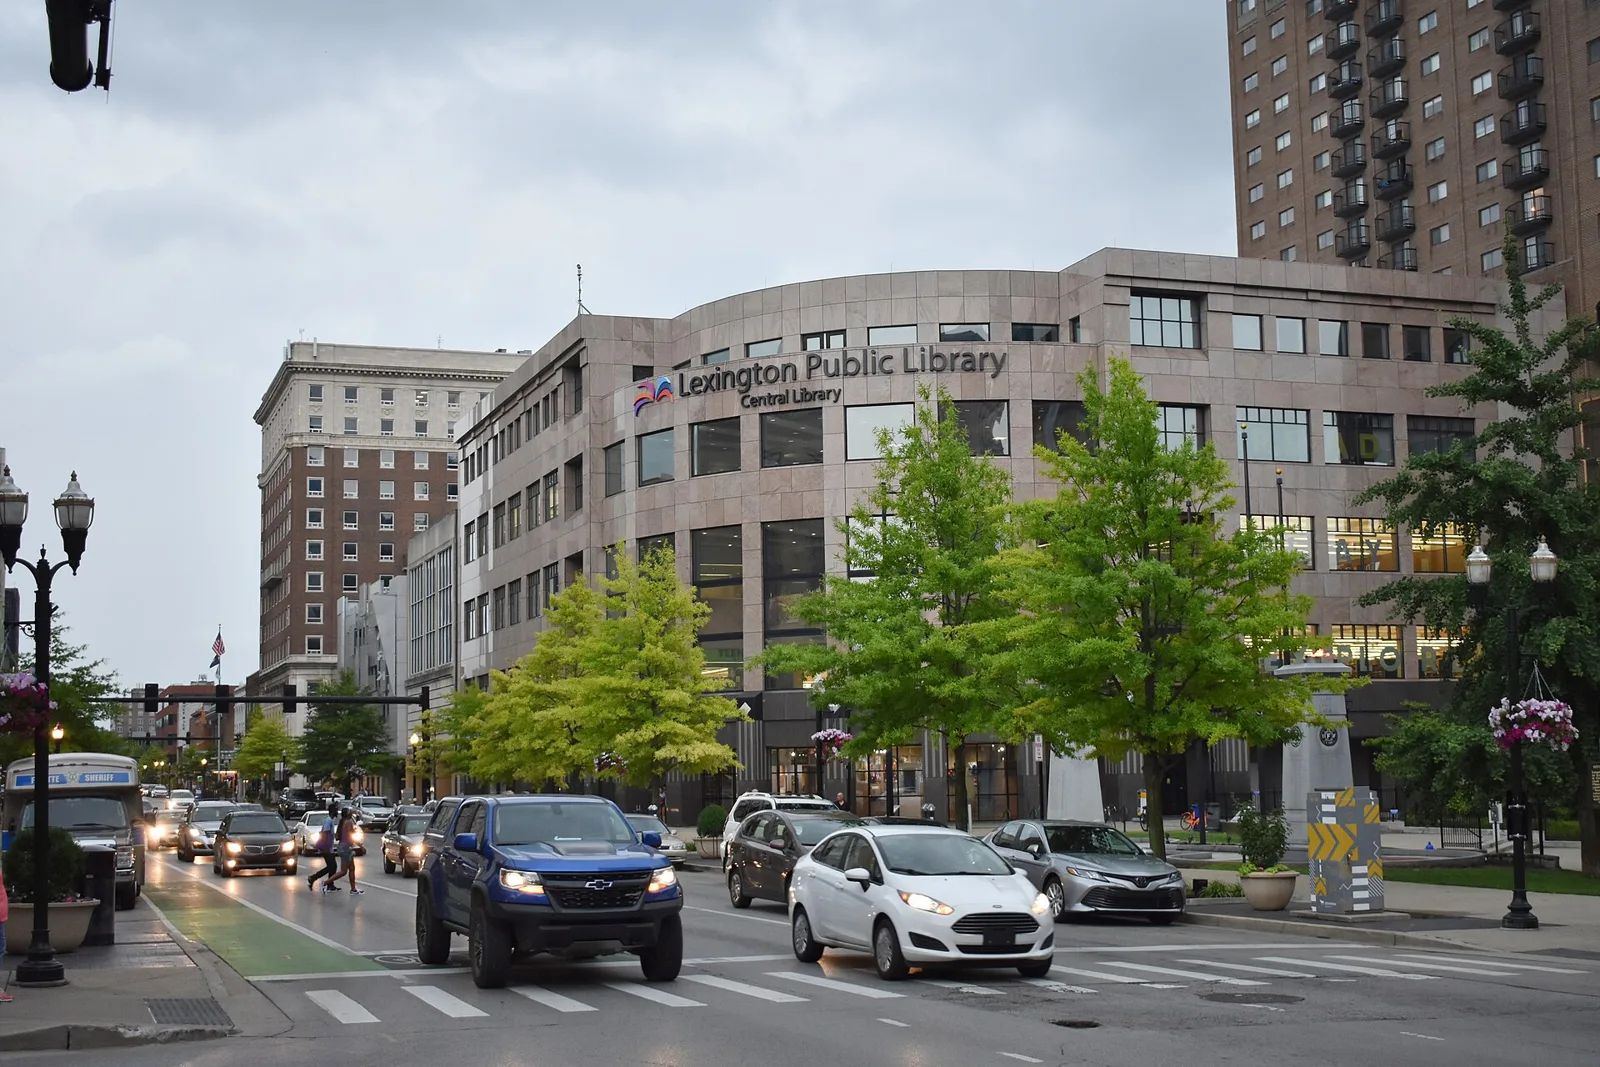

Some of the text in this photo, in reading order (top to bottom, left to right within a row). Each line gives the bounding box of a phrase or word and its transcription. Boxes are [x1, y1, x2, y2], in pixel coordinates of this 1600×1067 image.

[679, 345, 1008, 398] Lexington Public Library
[741, 387, 842, 409] Central Library
[31, 774, 115, 785] FTTE SHERIFF
